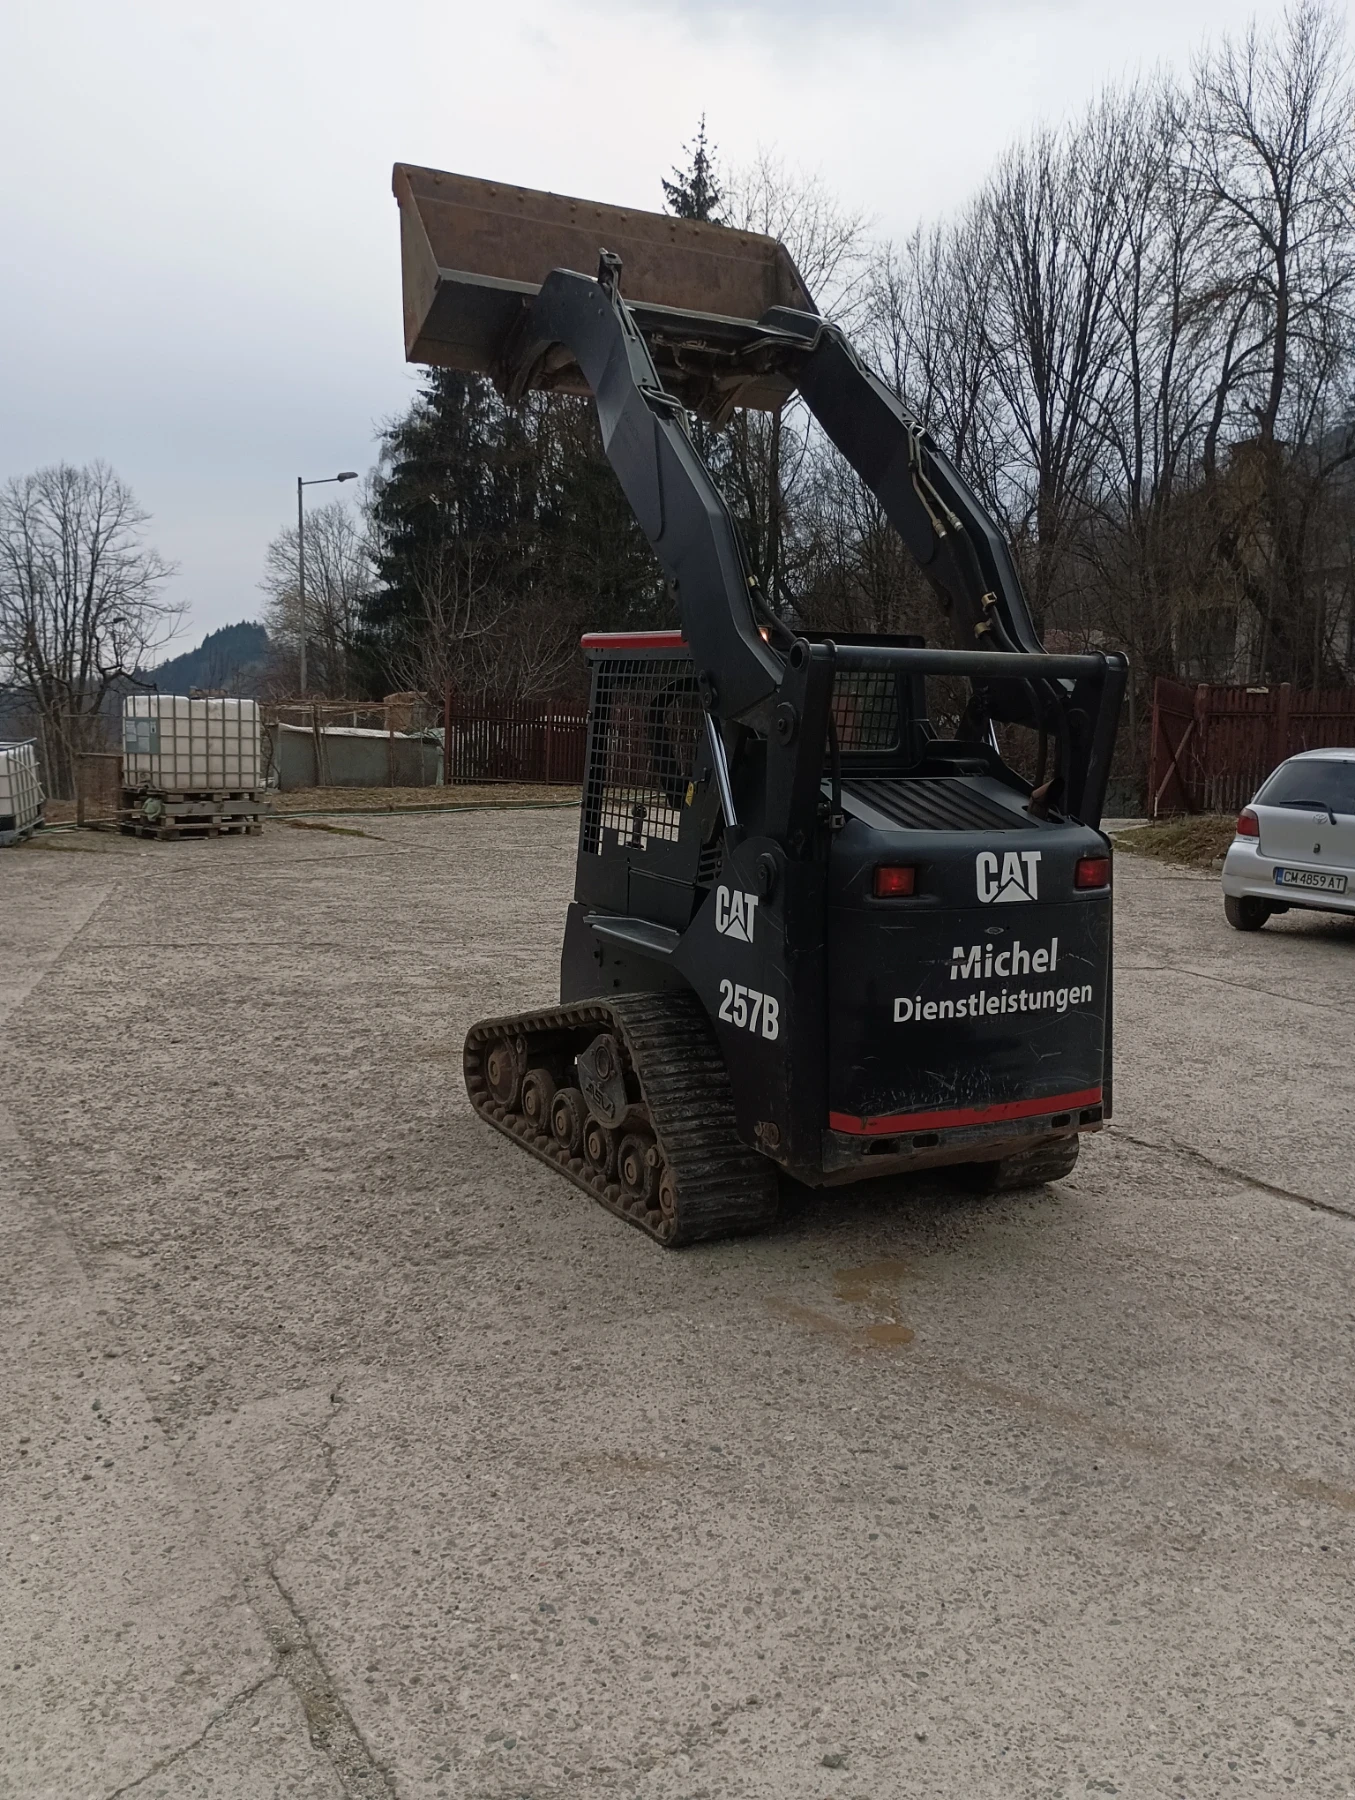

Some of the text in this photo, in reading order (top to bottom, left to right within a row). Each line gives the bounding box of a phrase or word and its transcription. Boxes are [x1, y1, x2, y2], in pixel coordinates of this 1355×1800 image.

[975, 851, 1042, 903] CAT
[1283, 871, 1299, 883] CM
[1299, 873, 1326, 887] 4859
[1327, 877, 1344, 889] AT
[715, 885, 759, 943] CAT
[950, 937, 1059, 980] Michel
[718, 979, 780, 1041] 257B
[893, 984, 1093, 1023] Dienstleistungen
